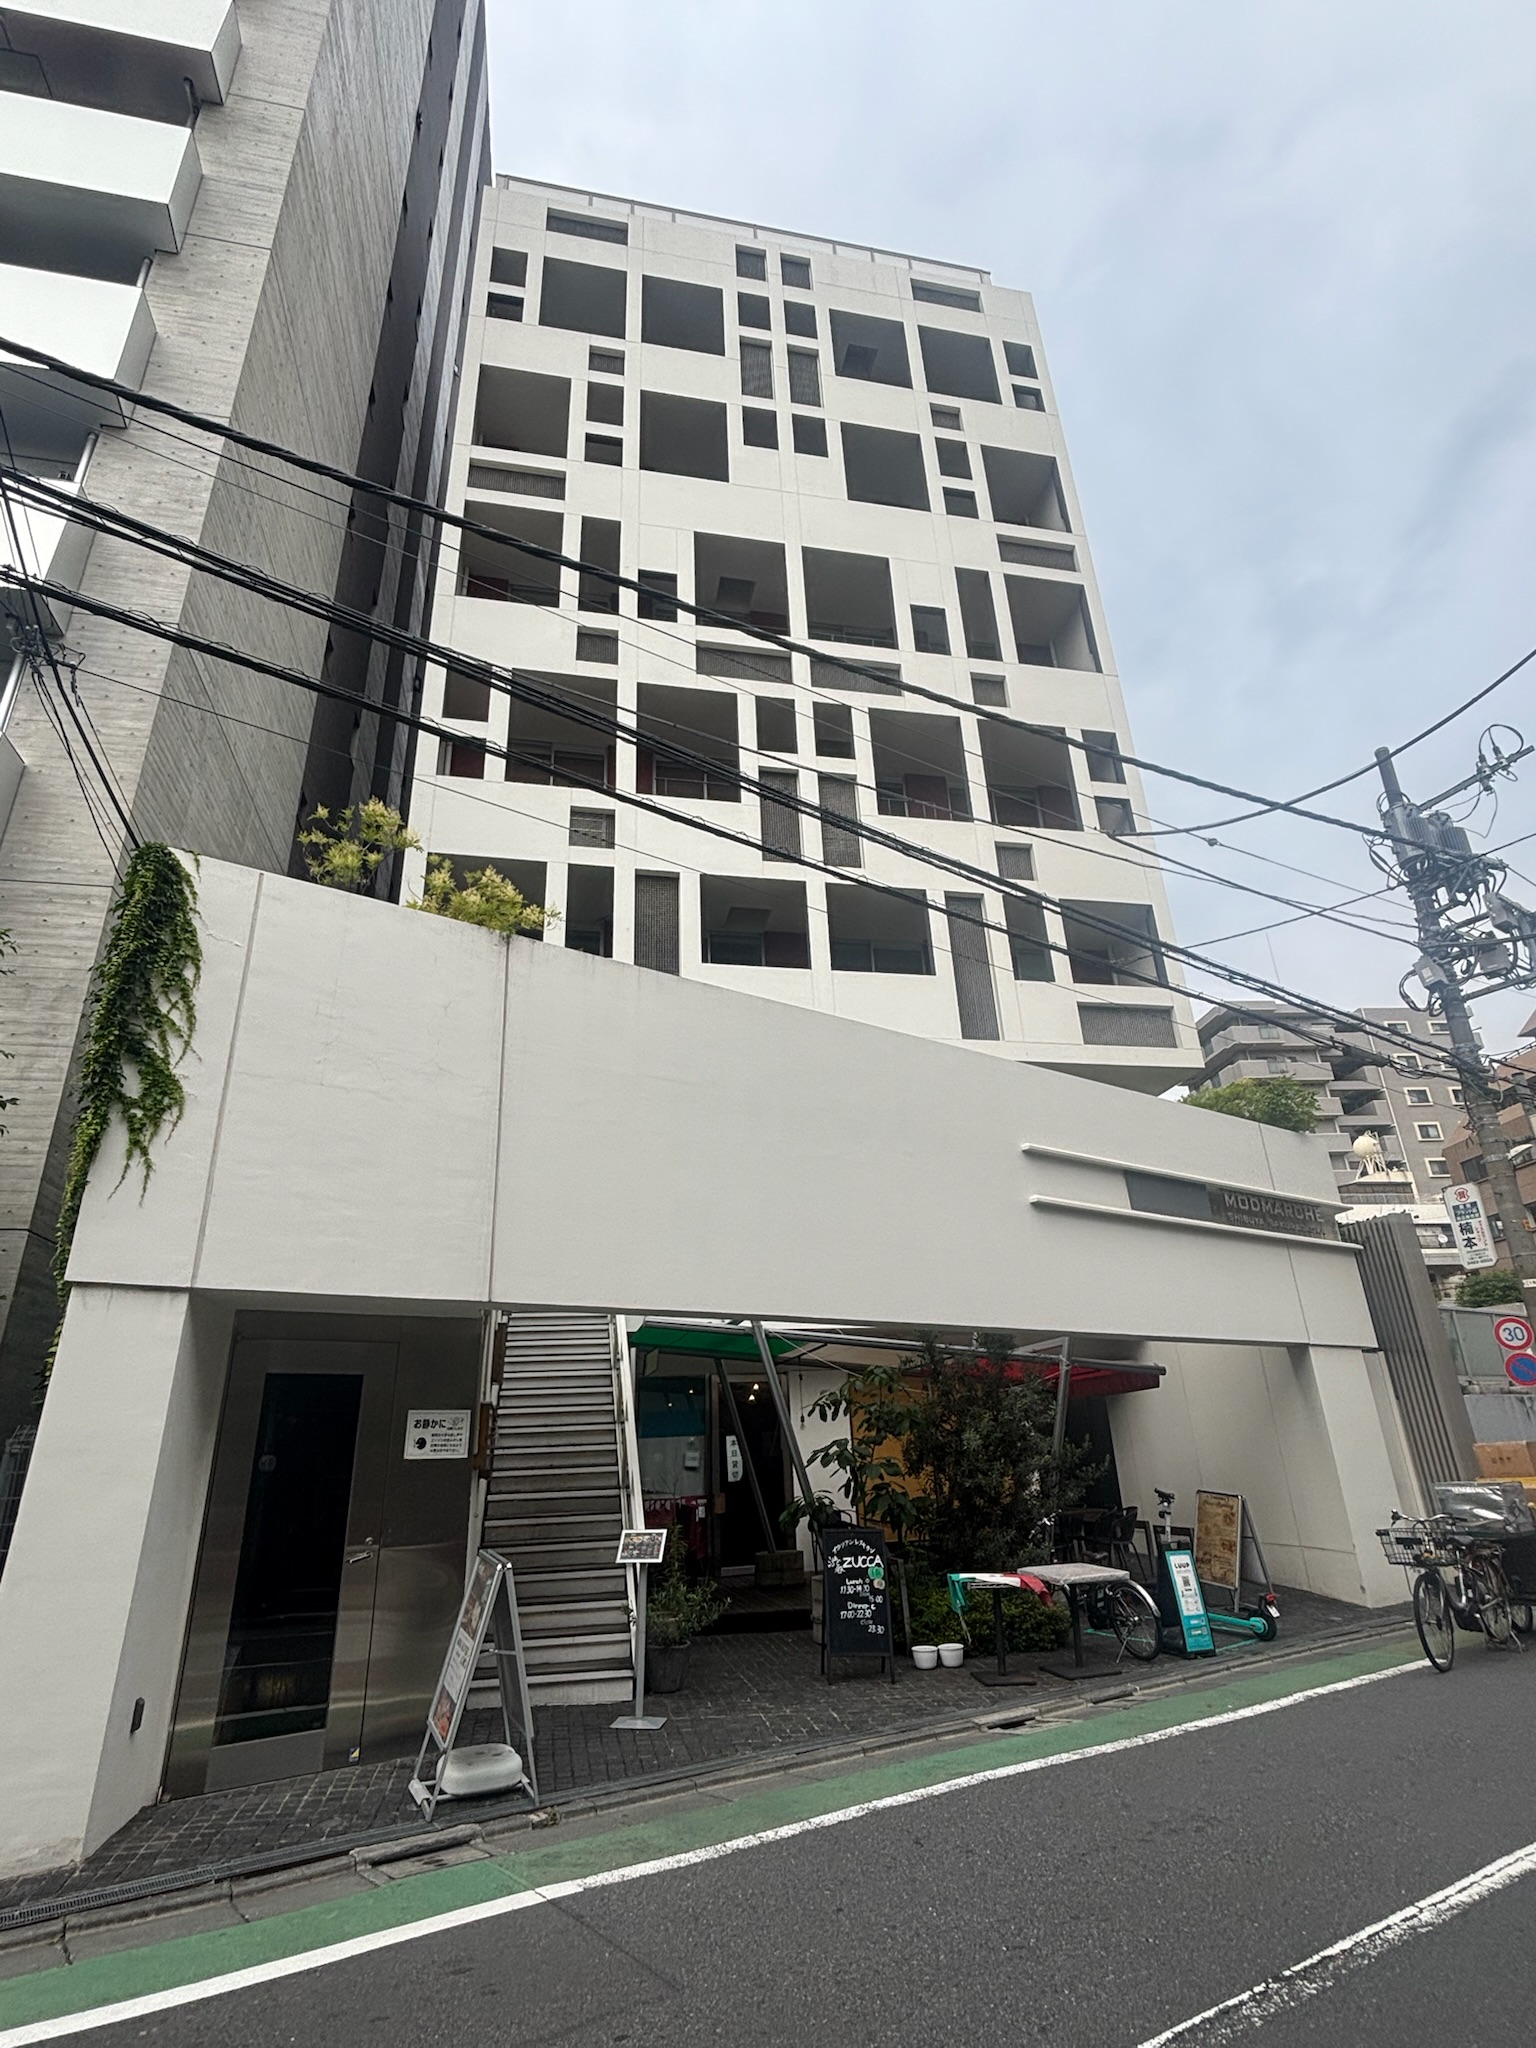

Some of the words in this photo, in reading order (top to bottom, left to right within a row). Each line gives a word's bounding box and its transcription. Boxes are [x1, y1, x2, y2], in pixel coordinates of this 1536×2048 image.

[1224, 1193, 1325, 1222] MODMARCHE
[1503, 1326, 1525, 1341] 30
[414, 1419, 446, 1429] お静かに
[842, 1555, 884, 1568] ZUCCA
